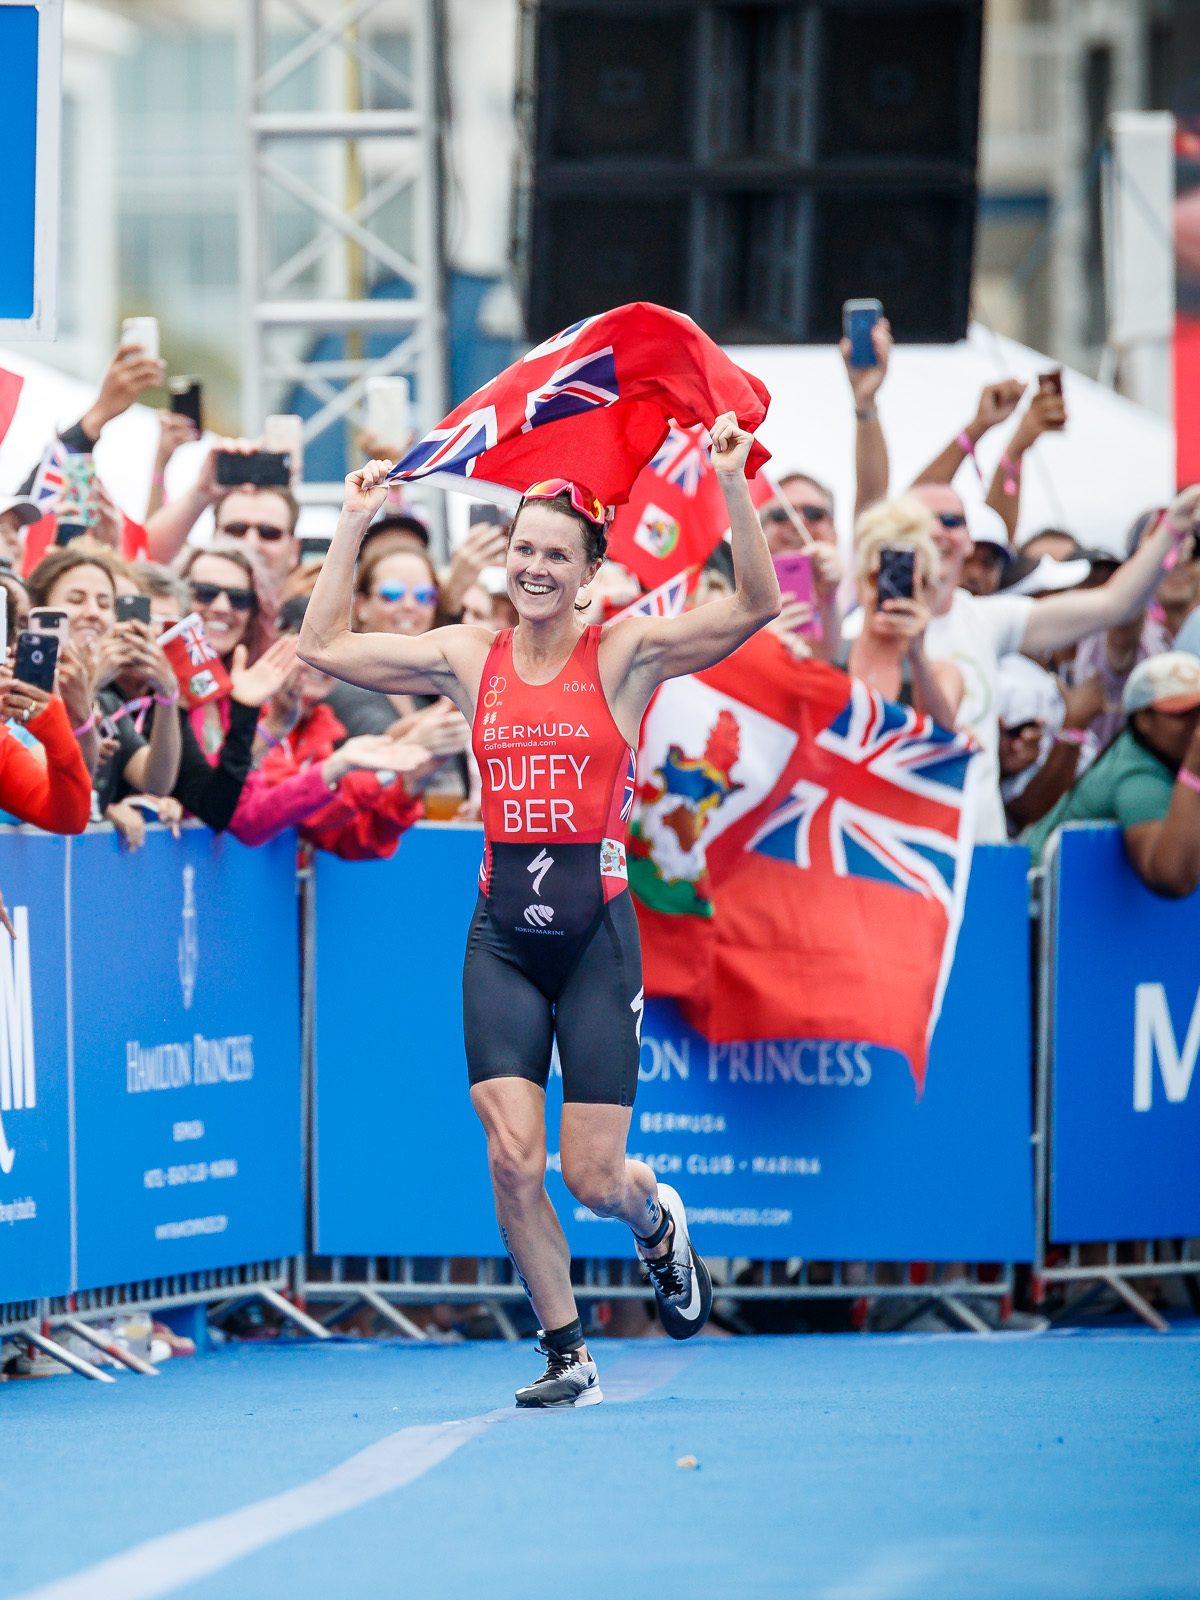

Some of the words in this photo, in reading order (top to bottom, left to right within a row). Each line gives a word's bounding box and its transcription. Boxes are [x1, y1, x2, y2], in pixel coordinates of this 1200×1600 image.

[483, 722, 590, 742] BERMUDA
[484, 740, 557, 751] GoToBermuda.com
[486, 754, 591, 792] DUFFY
[503, 799, 578, 833] BER
[514, 926, 536, 934] TOKIO
[708, 1040, 873, 1087] PRINCESS
